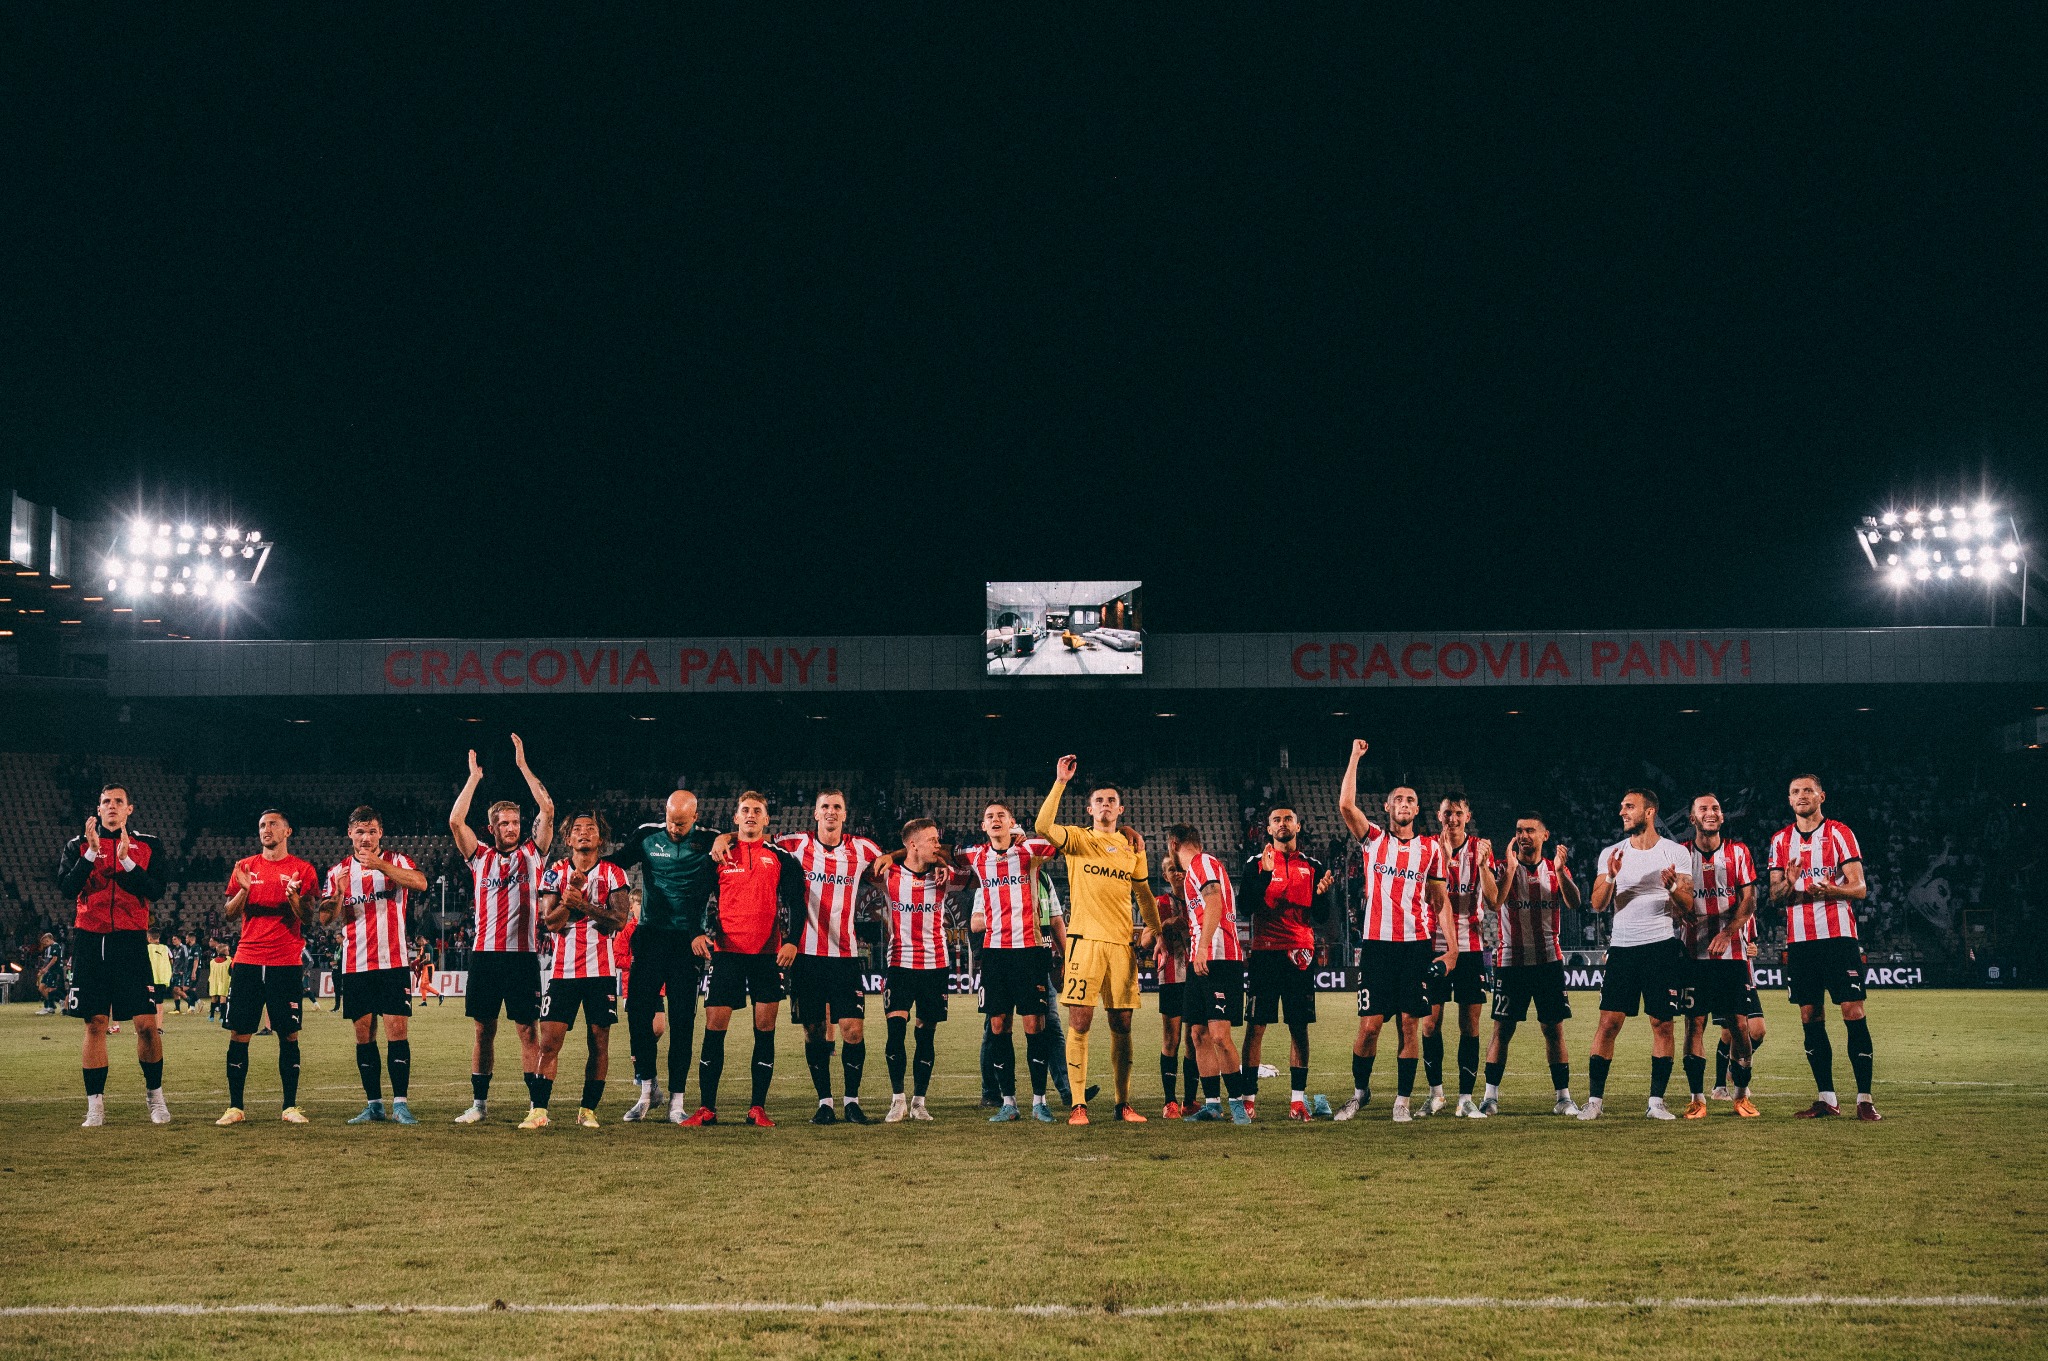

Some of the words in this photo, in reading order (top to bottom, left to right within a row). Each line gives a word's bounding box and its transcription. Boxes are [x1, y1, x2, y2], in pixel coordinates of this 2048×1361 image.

[384, 647, 661, 687] CRACOVIA
[680, 646, 838, 686] PANY!
[1291, 641, 1572, 681] CRACOVIA
[1591, 639, 1751, 679] PANY!
[480, 873, 531, 888] COMARCH
[803, 871, 855, 885] COMARCH
[1083, 863, 1131, 881] COMARC
[1800, 866, 1837, 878] MARCH
[1067, 978, 1087, 1000] 23
[1681, 987, 1695, 1009] 5
[1494, 993, 1511, 1016] 22
